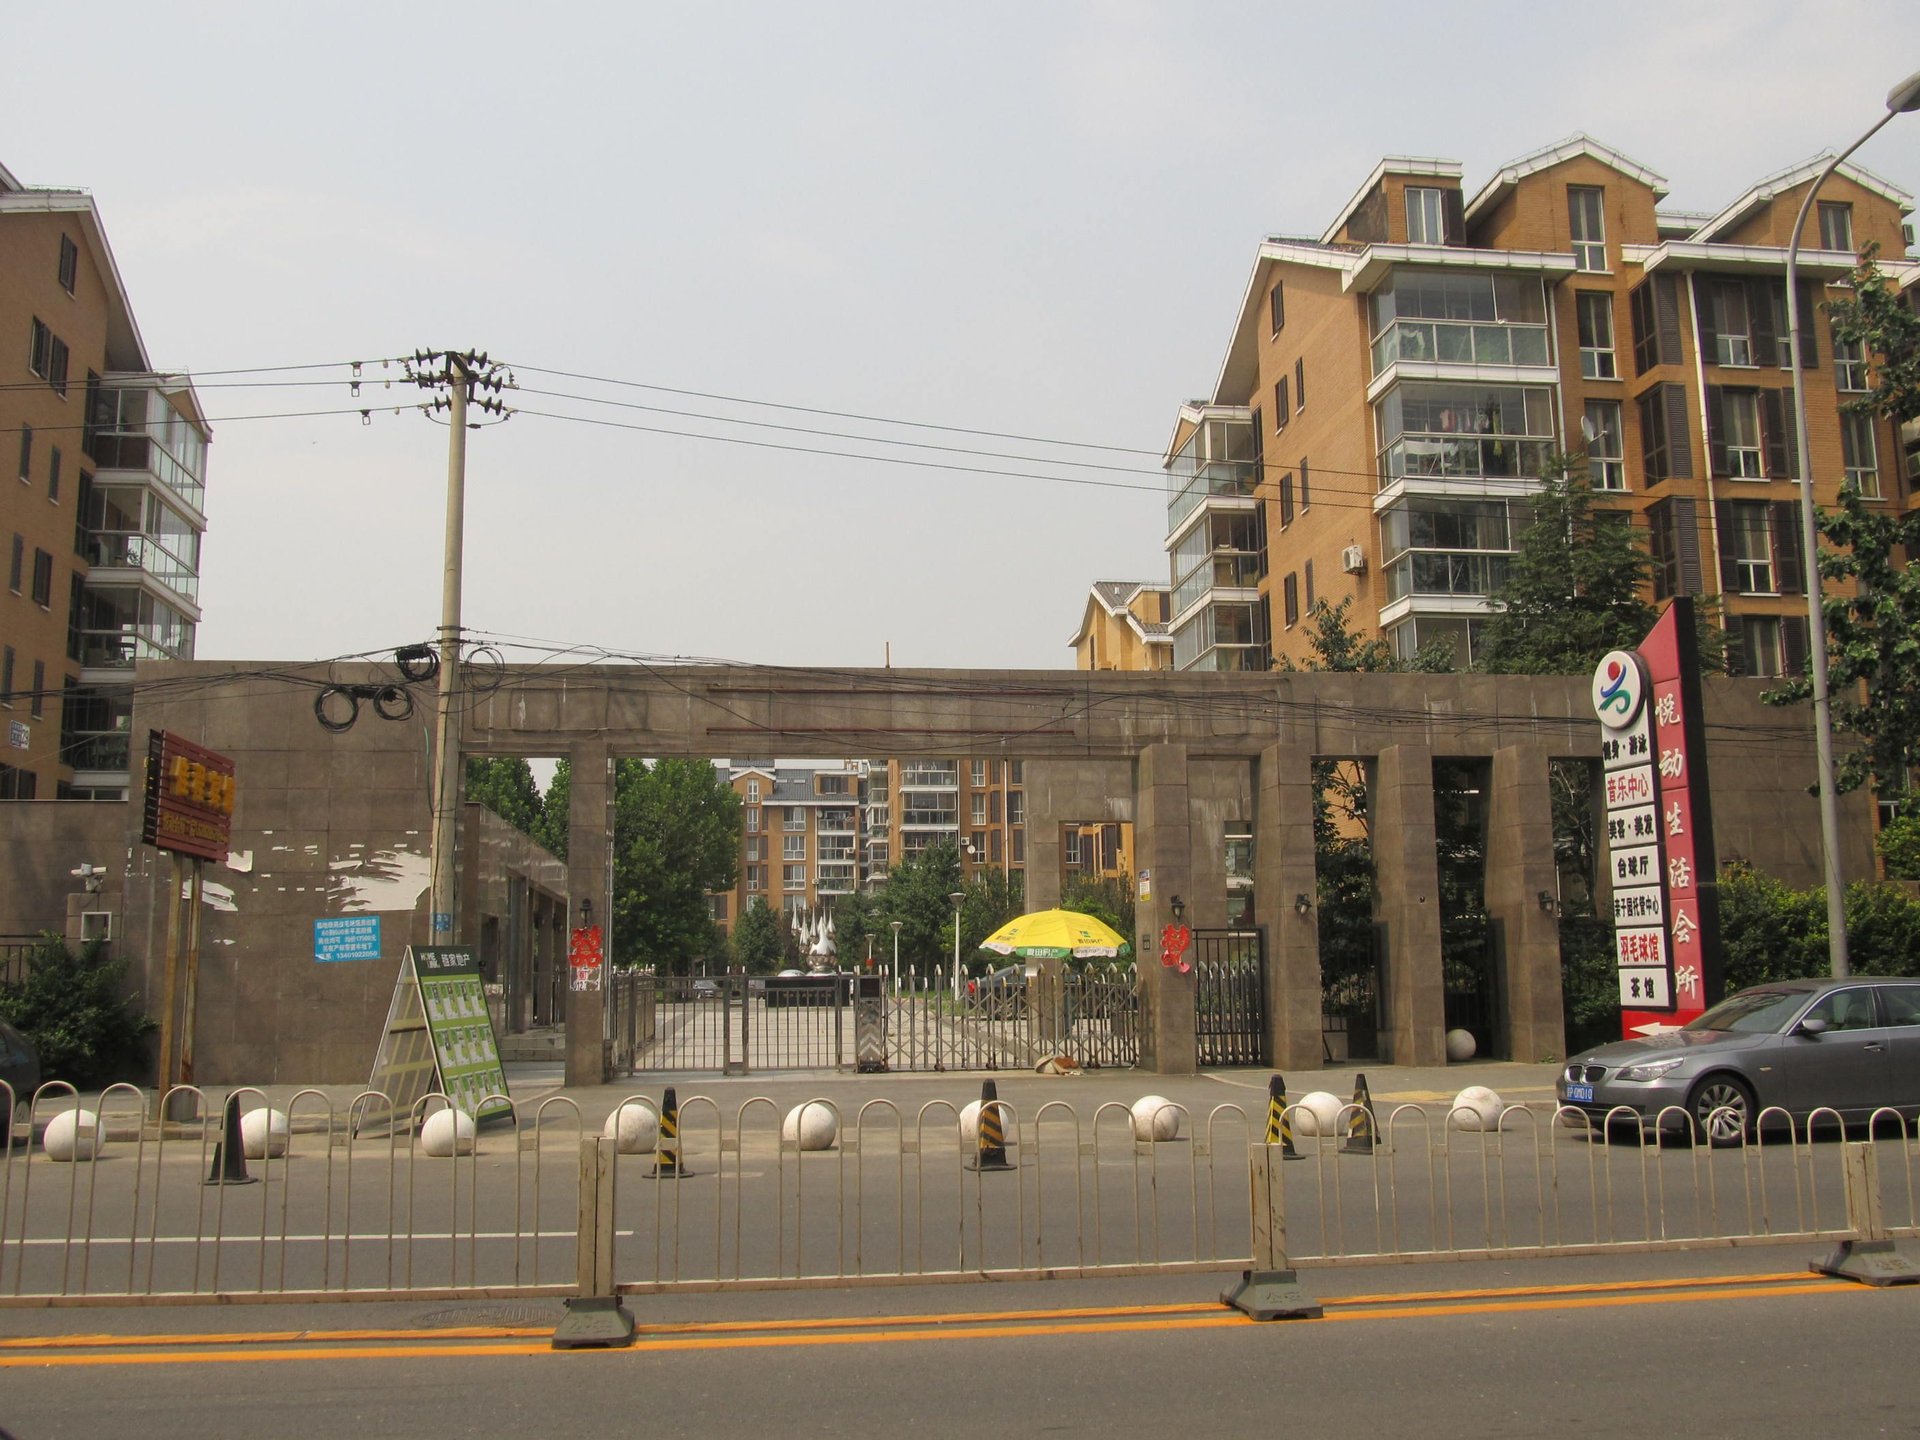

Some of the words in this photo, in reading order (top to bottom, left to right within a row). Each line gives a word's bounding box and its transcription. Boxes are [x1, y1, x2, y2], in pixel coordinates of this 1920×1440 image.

[1603, 733, 1648, 761] 健身·游泳
[1607, 773, 1649, 803] 音乐中心
[1608, 814, 1654, 840] 美容·美发
[1655, 693, 1698, 1000] 悦动生活会所
[1617, 855, 1649, 878] 台球厅
[1614, 895, 1660, 918] 亲子园托管中心
[441, 953, 470, 968] 链家地产
[1620, 933, 1660, 962] 羽毛球馆
[1630, 977, 1655, 999] 茶馆
